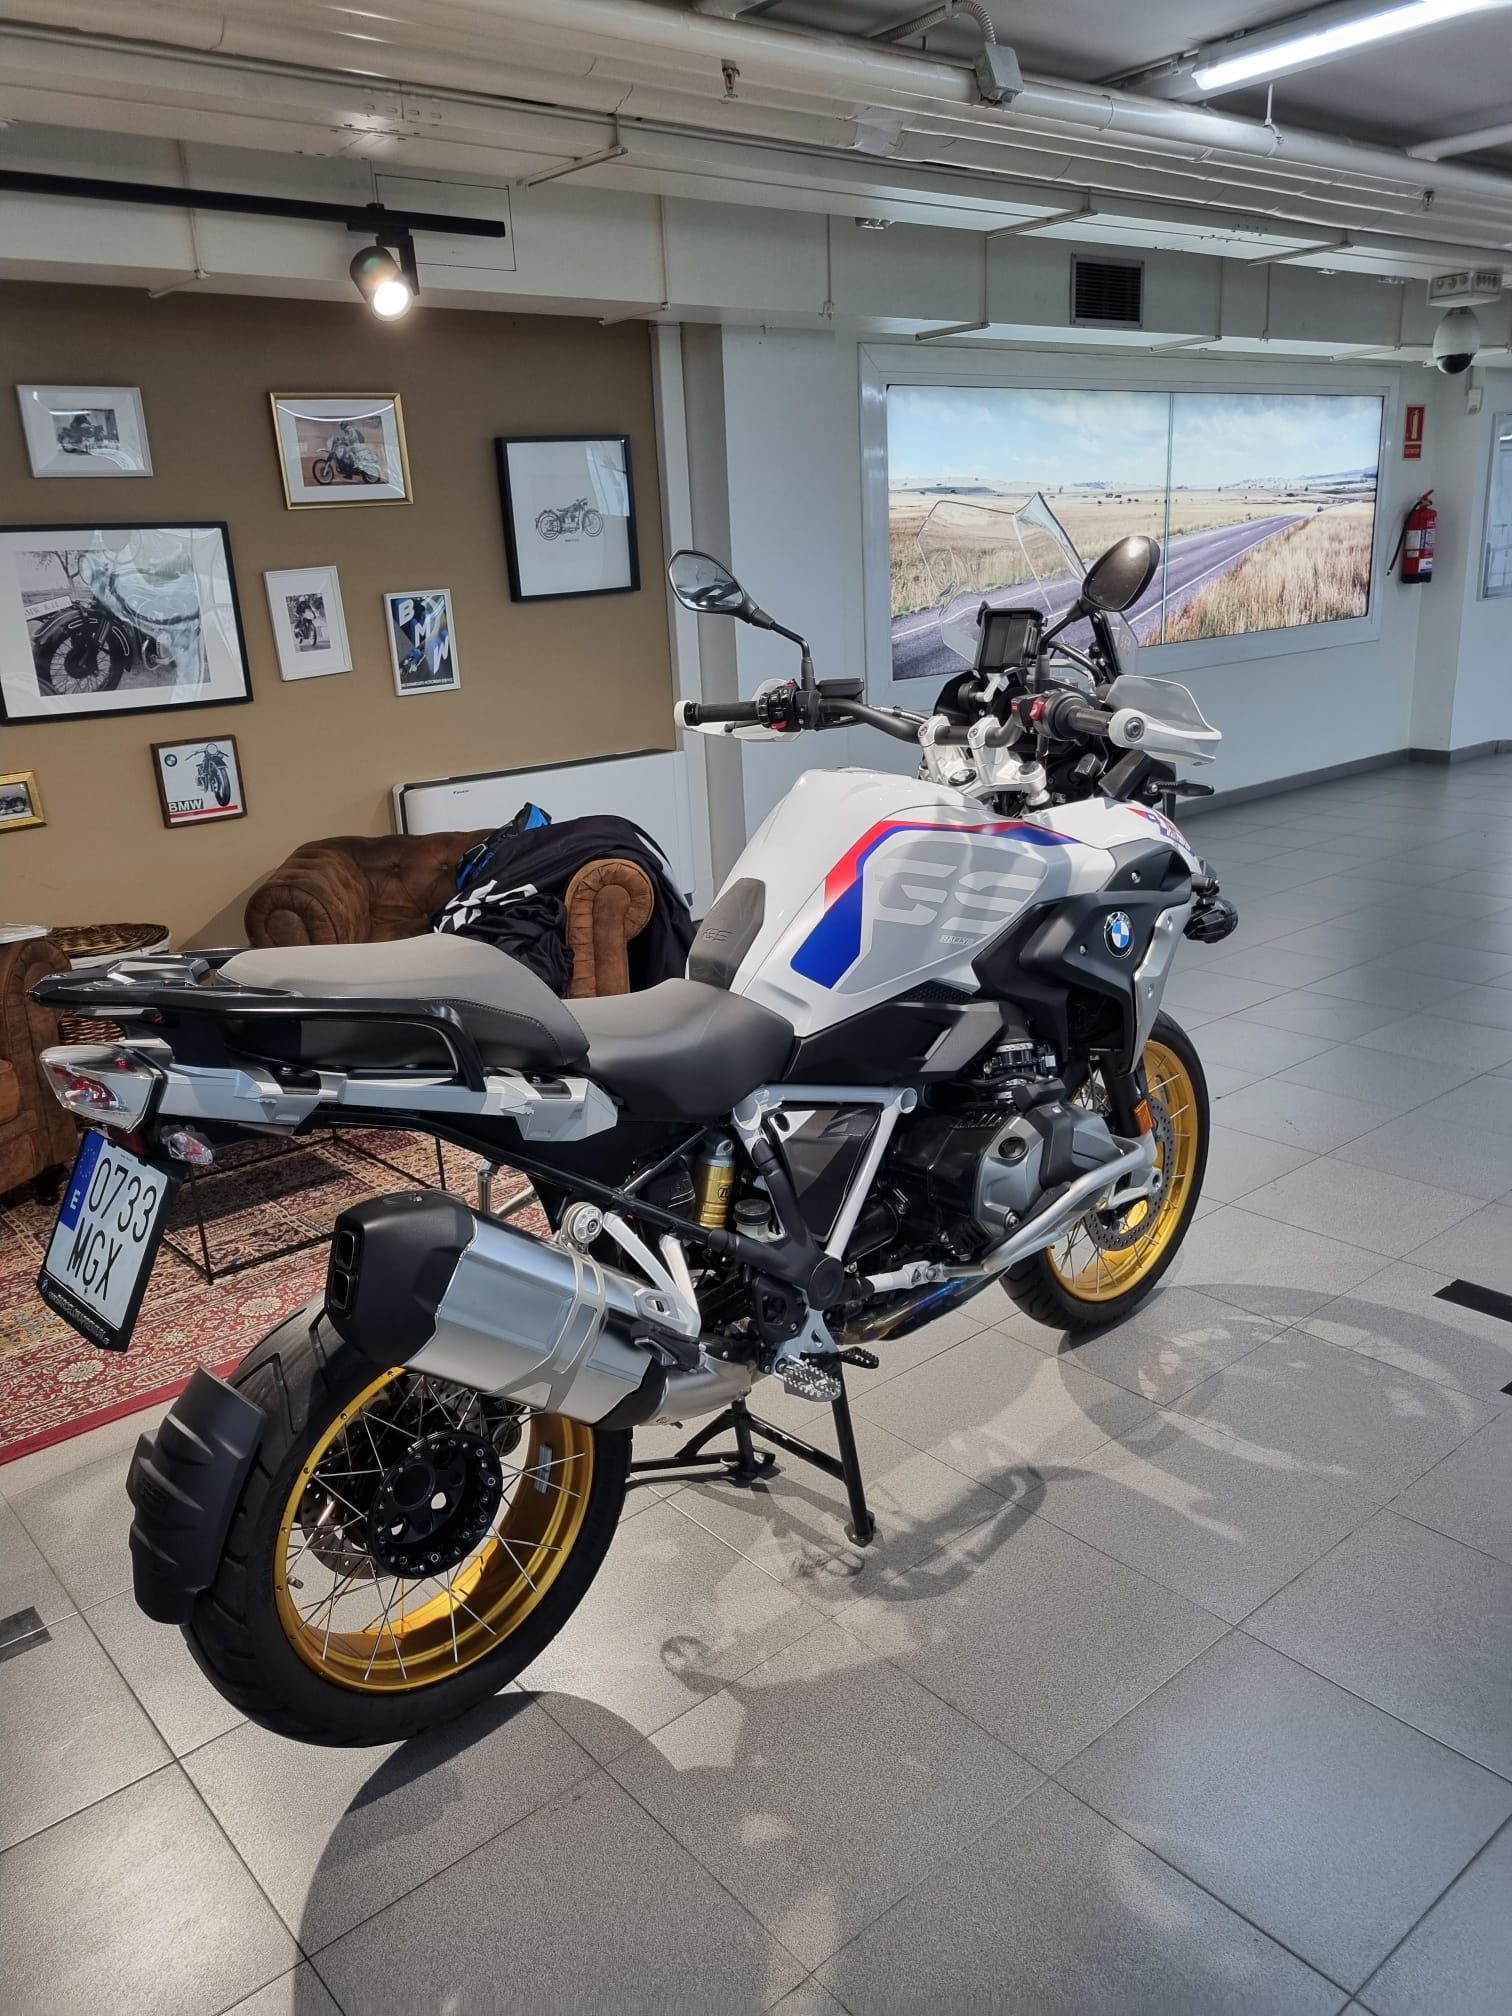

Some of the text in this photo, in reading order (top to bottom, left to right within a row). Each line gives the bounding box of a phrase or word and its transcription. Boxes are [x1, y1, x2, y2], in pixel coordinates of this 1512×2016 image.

[168, 799, 203, 813] BMW
[69, 1190, 81, 1210] E
[88, 1157, 157, 1243] 0733
[66, 1216, 123, 1301] MGX
